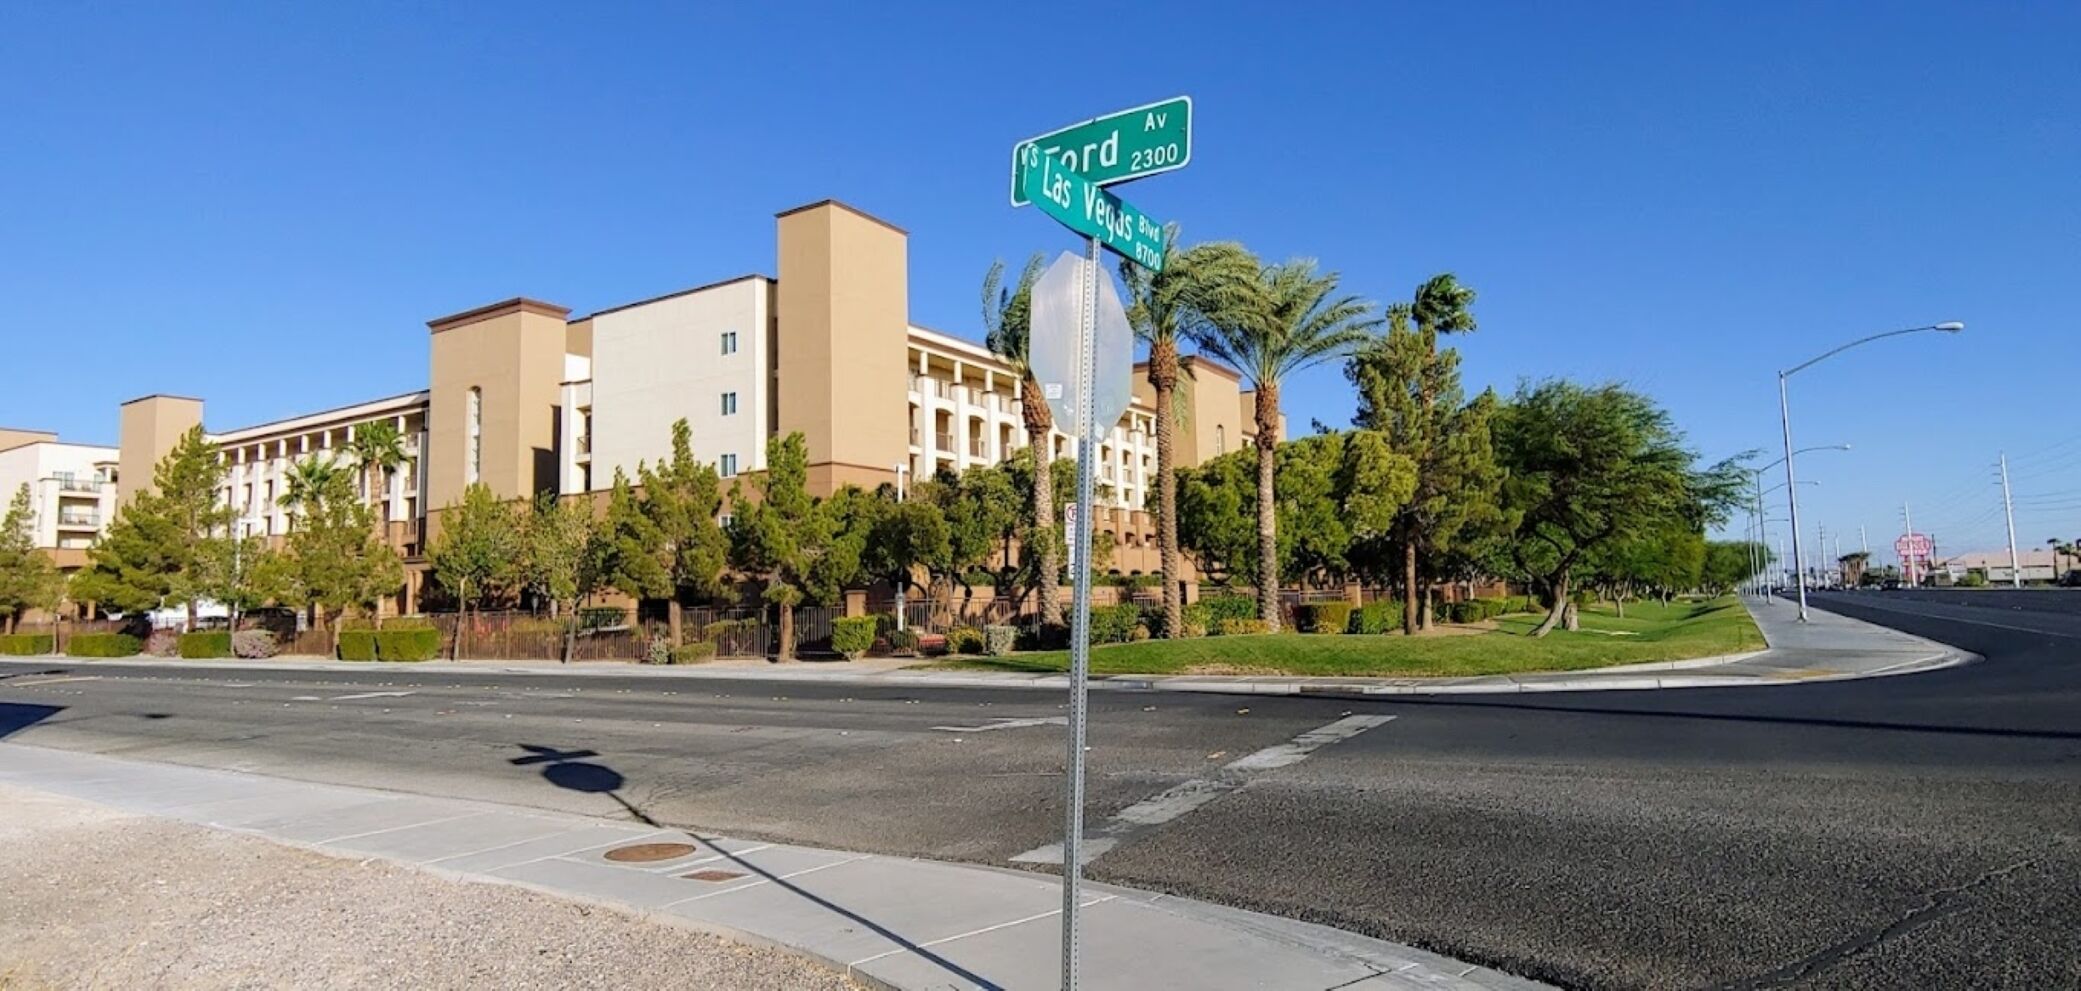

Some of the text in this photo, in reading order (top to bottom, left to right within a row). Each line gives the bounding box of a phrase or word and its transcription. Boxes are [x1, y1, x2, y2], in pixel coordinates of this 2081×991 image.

[1044, 130, 1119, 172] ord
[1144, 112, 1167, 132] Av
[1131, 143, 1178, 171] 2300
[1030, 147, 1038, 168] S
[1043, 156, 1072, 209] Las
[1084, 182, 1133, 243] Vegas
[1139, 217, 1160, 242] Blvd
[1136, 242, 1161, 270] 8700
